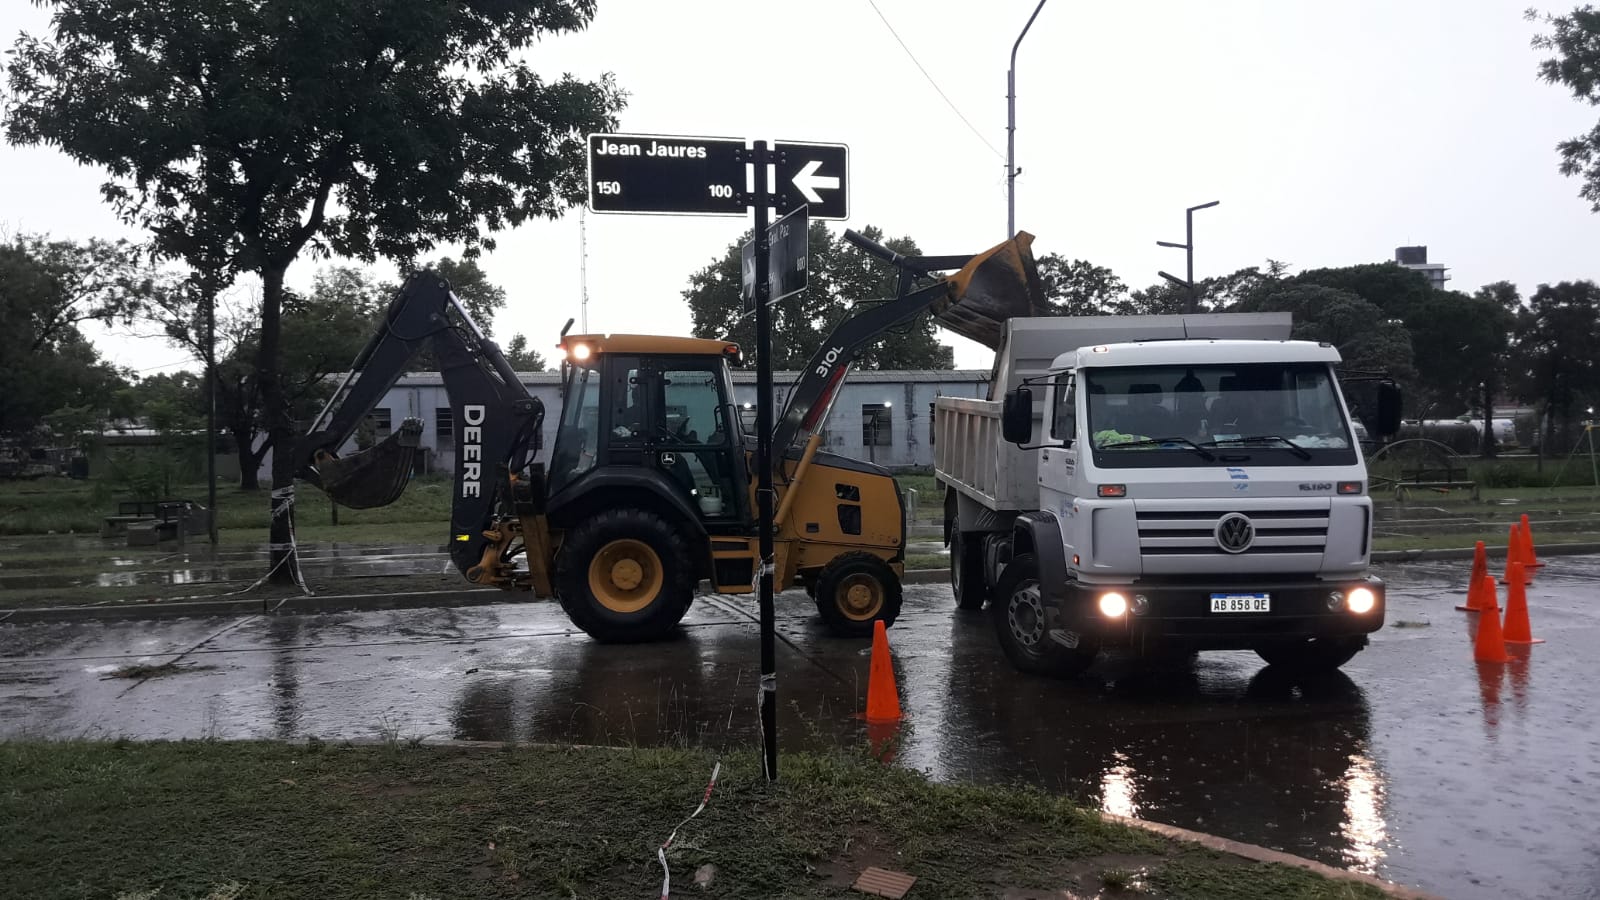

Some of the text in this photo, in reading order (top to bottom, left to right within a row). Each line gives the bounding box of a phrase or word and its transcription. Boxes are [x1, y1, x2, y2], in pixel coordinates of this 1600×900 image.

[596, 139, 707, 158] Jean Jaures
[596, 181, 733, 198] 150 100
[815, 346, 844, 378] 310L
[463, 405, 485, 498] DEERE
[1214, 600, 1267, 610] AB 858 QE
